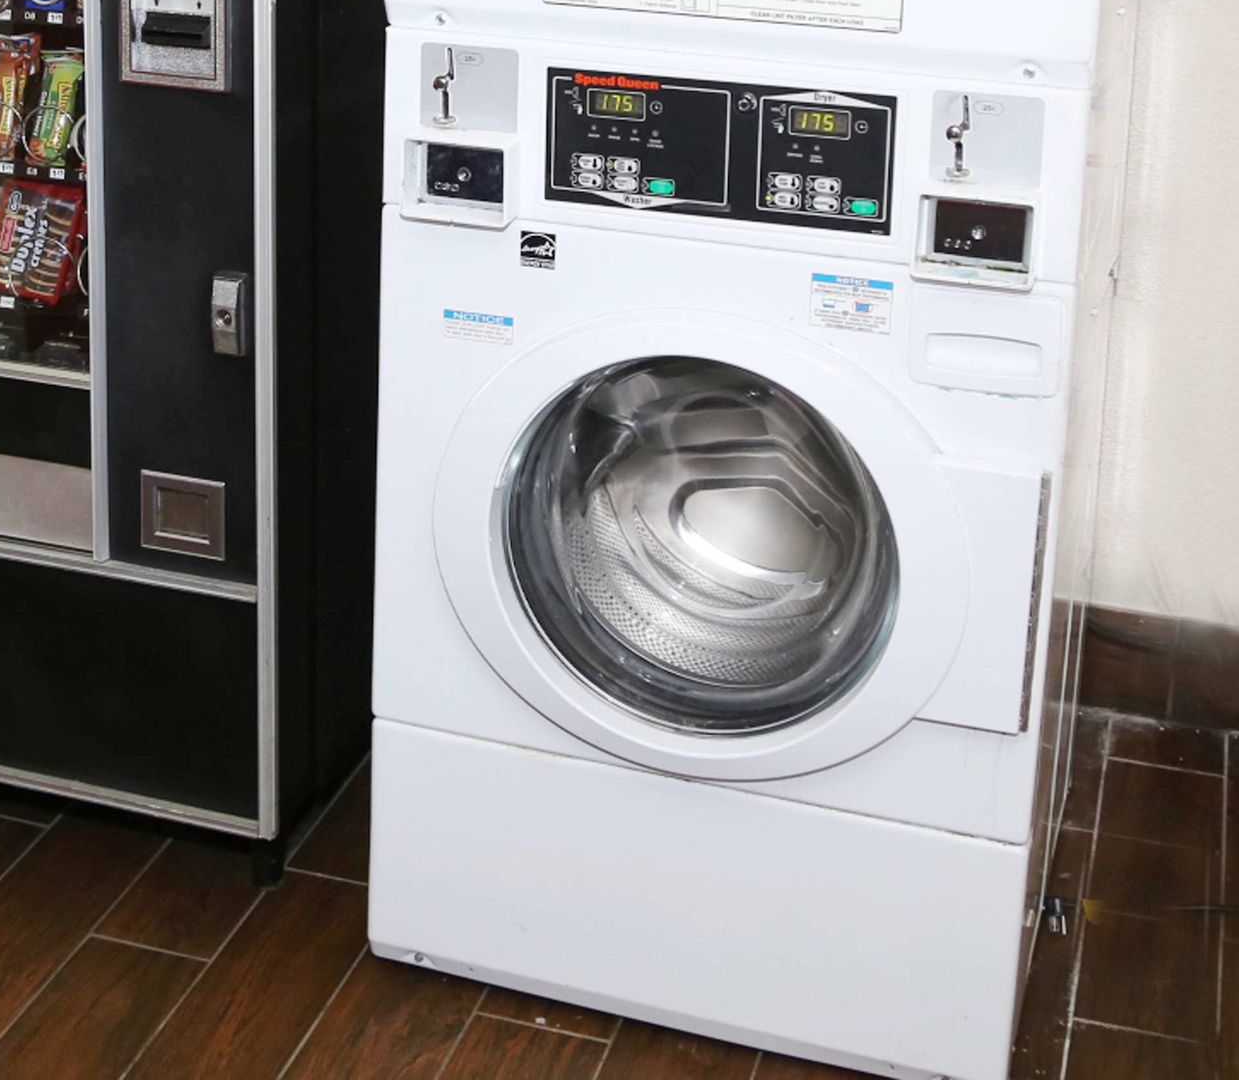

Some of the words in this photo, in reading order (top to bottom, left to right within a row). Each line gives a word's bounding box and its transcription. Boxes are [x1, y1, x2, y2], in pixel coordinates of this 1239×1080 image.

[574, 72, 616, 87] Speed
[617, 75, 661, 91] Queen
[601, 93, 634, 112] 175
[813, 92, 836, 104] Dryer
[801, 112, 835, 132] 175
[623, 195, 653, 206] Washer
[452, 310, 506, 325] NOTICE
